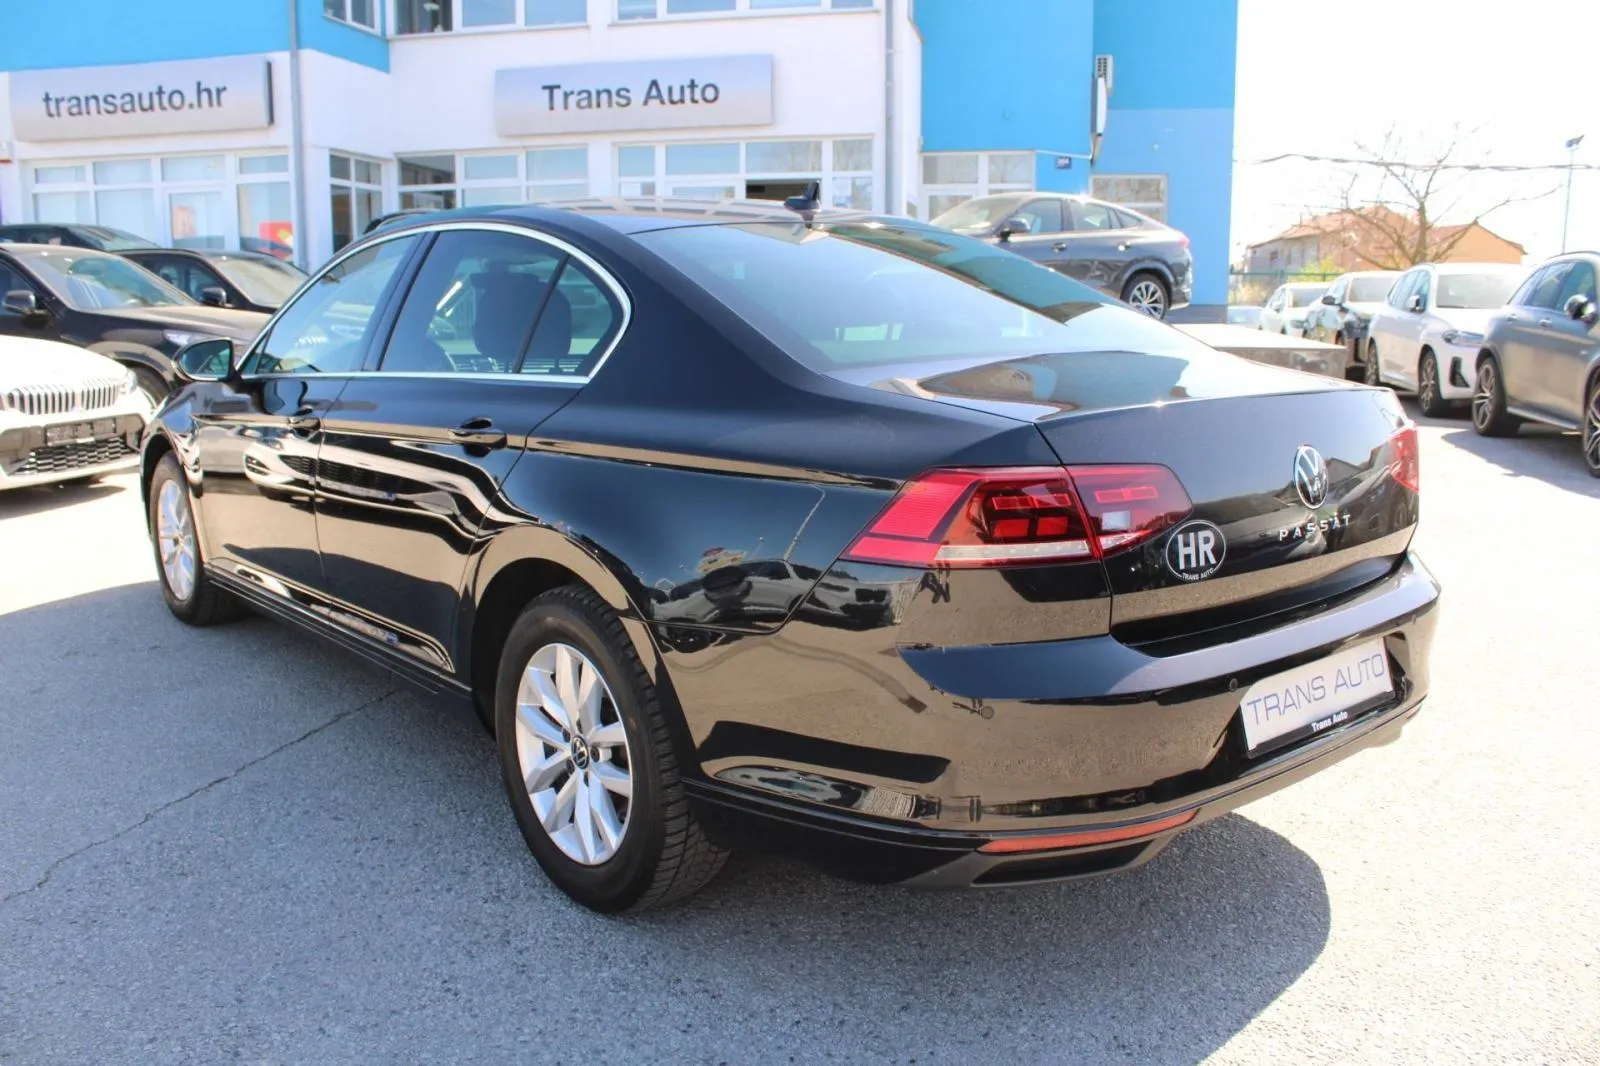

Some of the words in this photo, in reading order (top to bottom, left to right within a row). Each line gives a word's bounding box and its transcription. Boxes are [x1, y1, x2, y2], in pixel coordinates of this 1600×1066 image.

[42, 81, 227, 118] transauto.hr
[542, 84, 632, 111] Trans
[642, 78, 720, 107] Auto
[1279, 513, 1351, 541] PASSAT
[1177, 530, 1217, 570] HR
[1181, 572, 1200, 581] TRANS
[1200, 567, 1215, 579] AUTO
[1246, 675, 1326, 725] TRANS
[1334, 653, 1385, 694] AUTO
[1311, 719, 1332, 732] Trans
[1333, 711, 1348, 724] Auto
